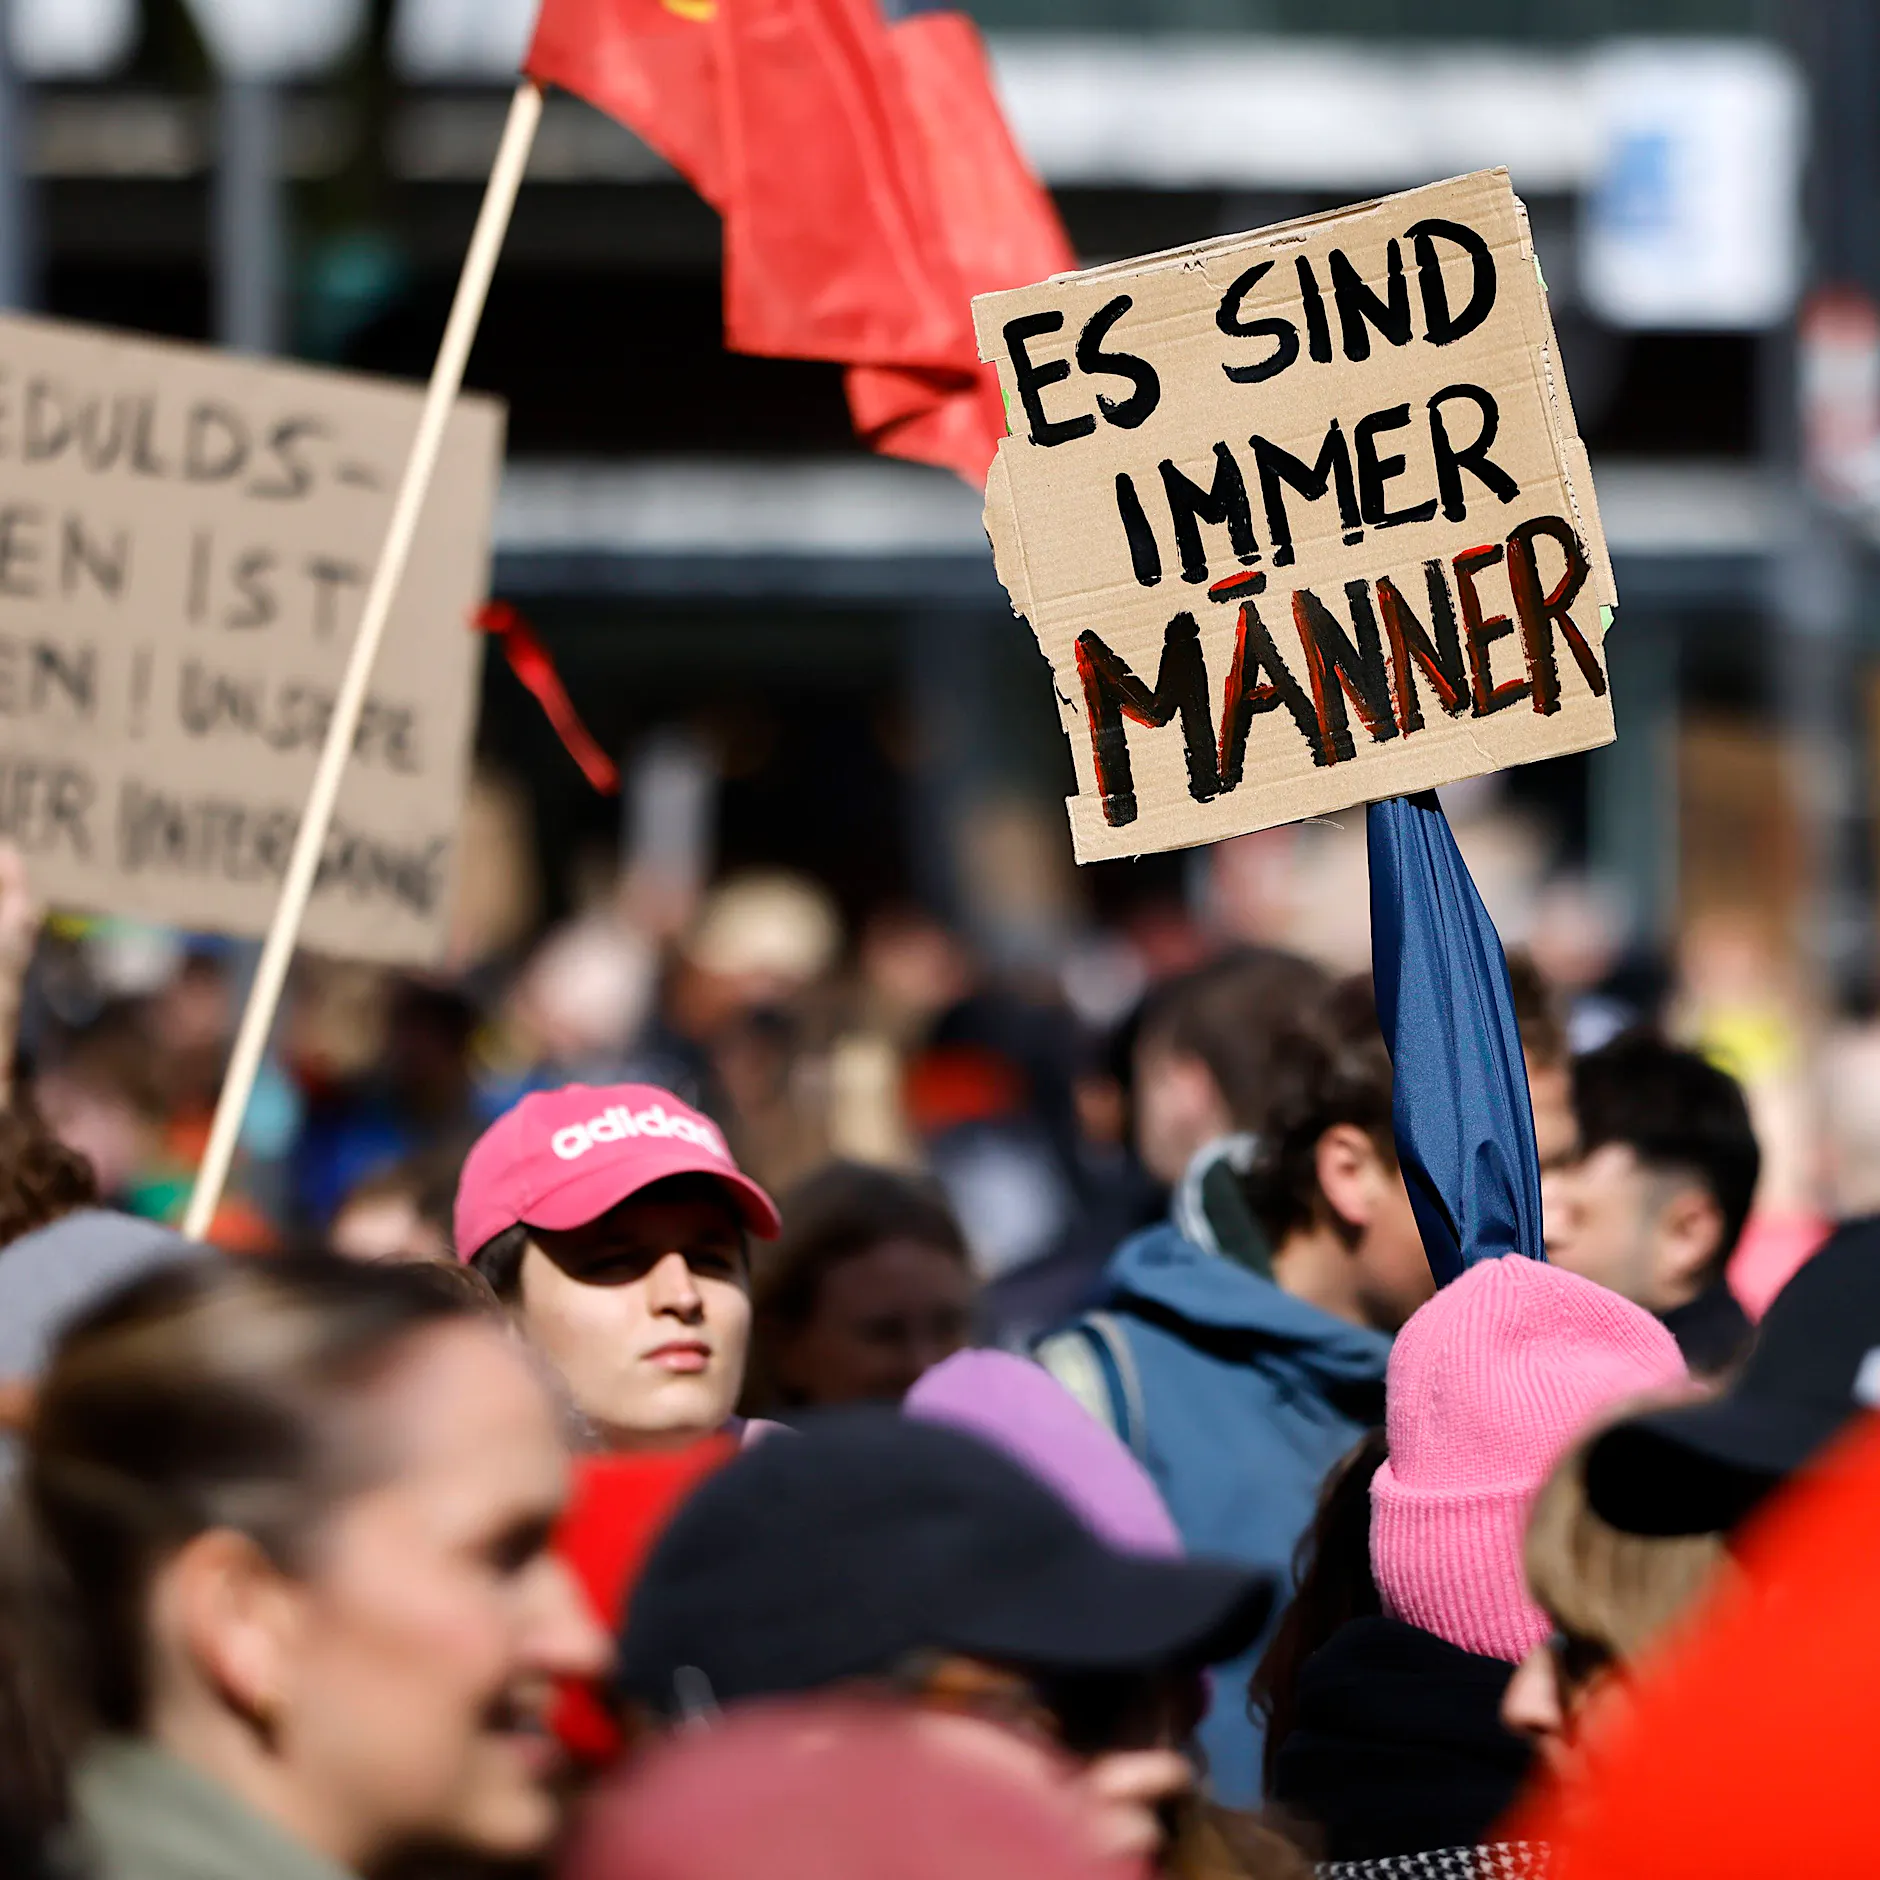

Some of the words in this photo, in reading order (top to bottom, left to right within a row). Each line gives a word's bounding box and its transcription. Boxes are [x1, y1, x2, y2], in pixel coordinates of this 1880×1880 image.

[1002, 295, 1161, 447] ES
[1215, 219, 1497, 384] SIND
[0, 372, 380, 500] DULDS-
[1115, 383, 1520, 587] IMMER
[183, 525, 368, 645] IST
